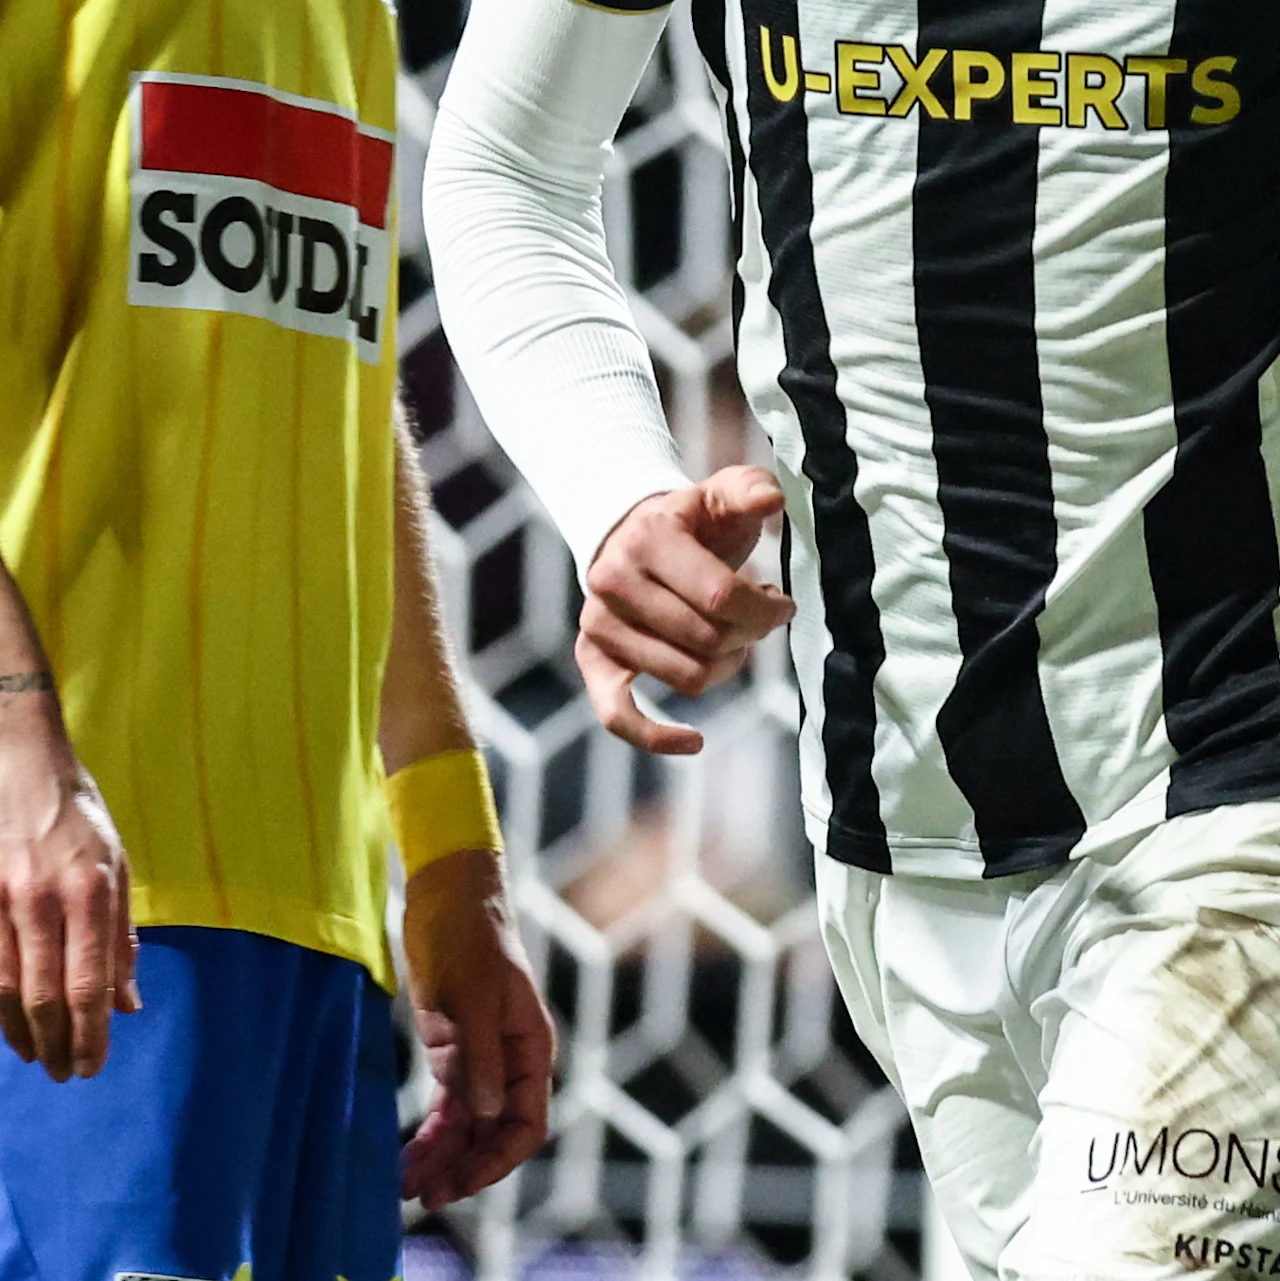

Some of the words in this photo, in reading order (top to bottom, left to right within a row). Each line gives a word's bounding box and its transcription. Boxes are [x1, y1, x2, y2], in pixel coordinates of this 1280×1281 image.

[759, 24, 1242, 130] U-EXPERTS
[138, 189, 379, 344] SOUDL
[1114, 1190, 1209, 1210] L'Université
[1213, 1197, 1236, 1213] du
